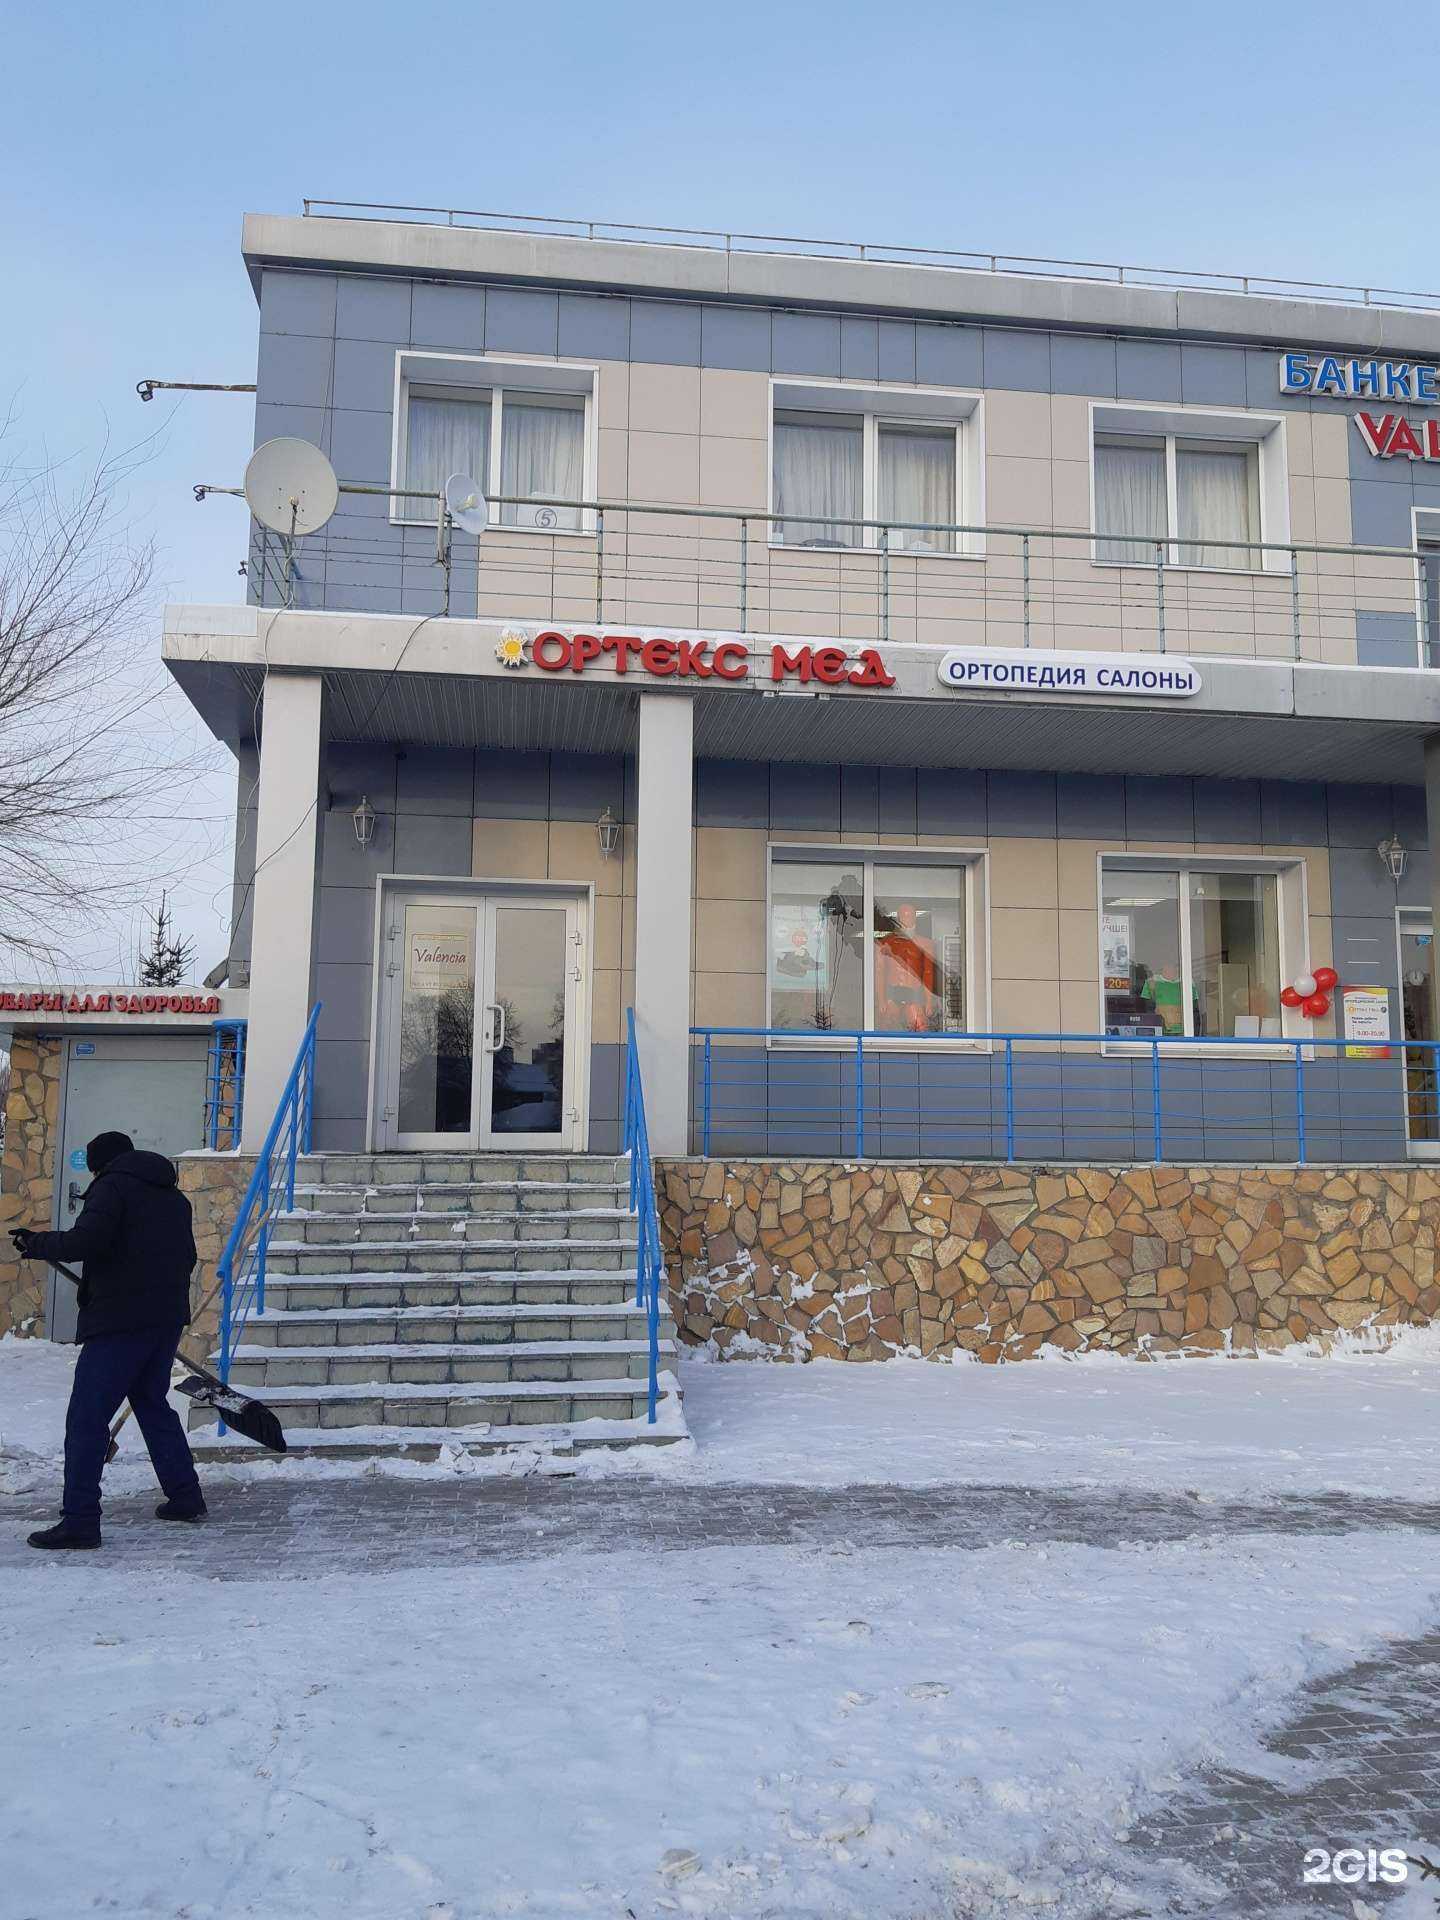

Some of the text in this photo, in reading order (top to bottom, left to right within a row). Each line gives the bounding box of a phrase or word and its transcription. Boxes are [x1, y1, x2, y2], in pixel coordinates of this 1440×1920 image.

[1280, 354, 1440, 404] БАНКЕ
[532, 631, 896, 688] ОРТЕКС МЕД
[949, 661, 1193, 690] ОРТОПЕДИЯ САЛОНЫ
[413, 946, 466, 963] Valencia
[0, 991, 221, 1014] ВАРЫ ДЛЯ ЗДОРОВЬЯ
